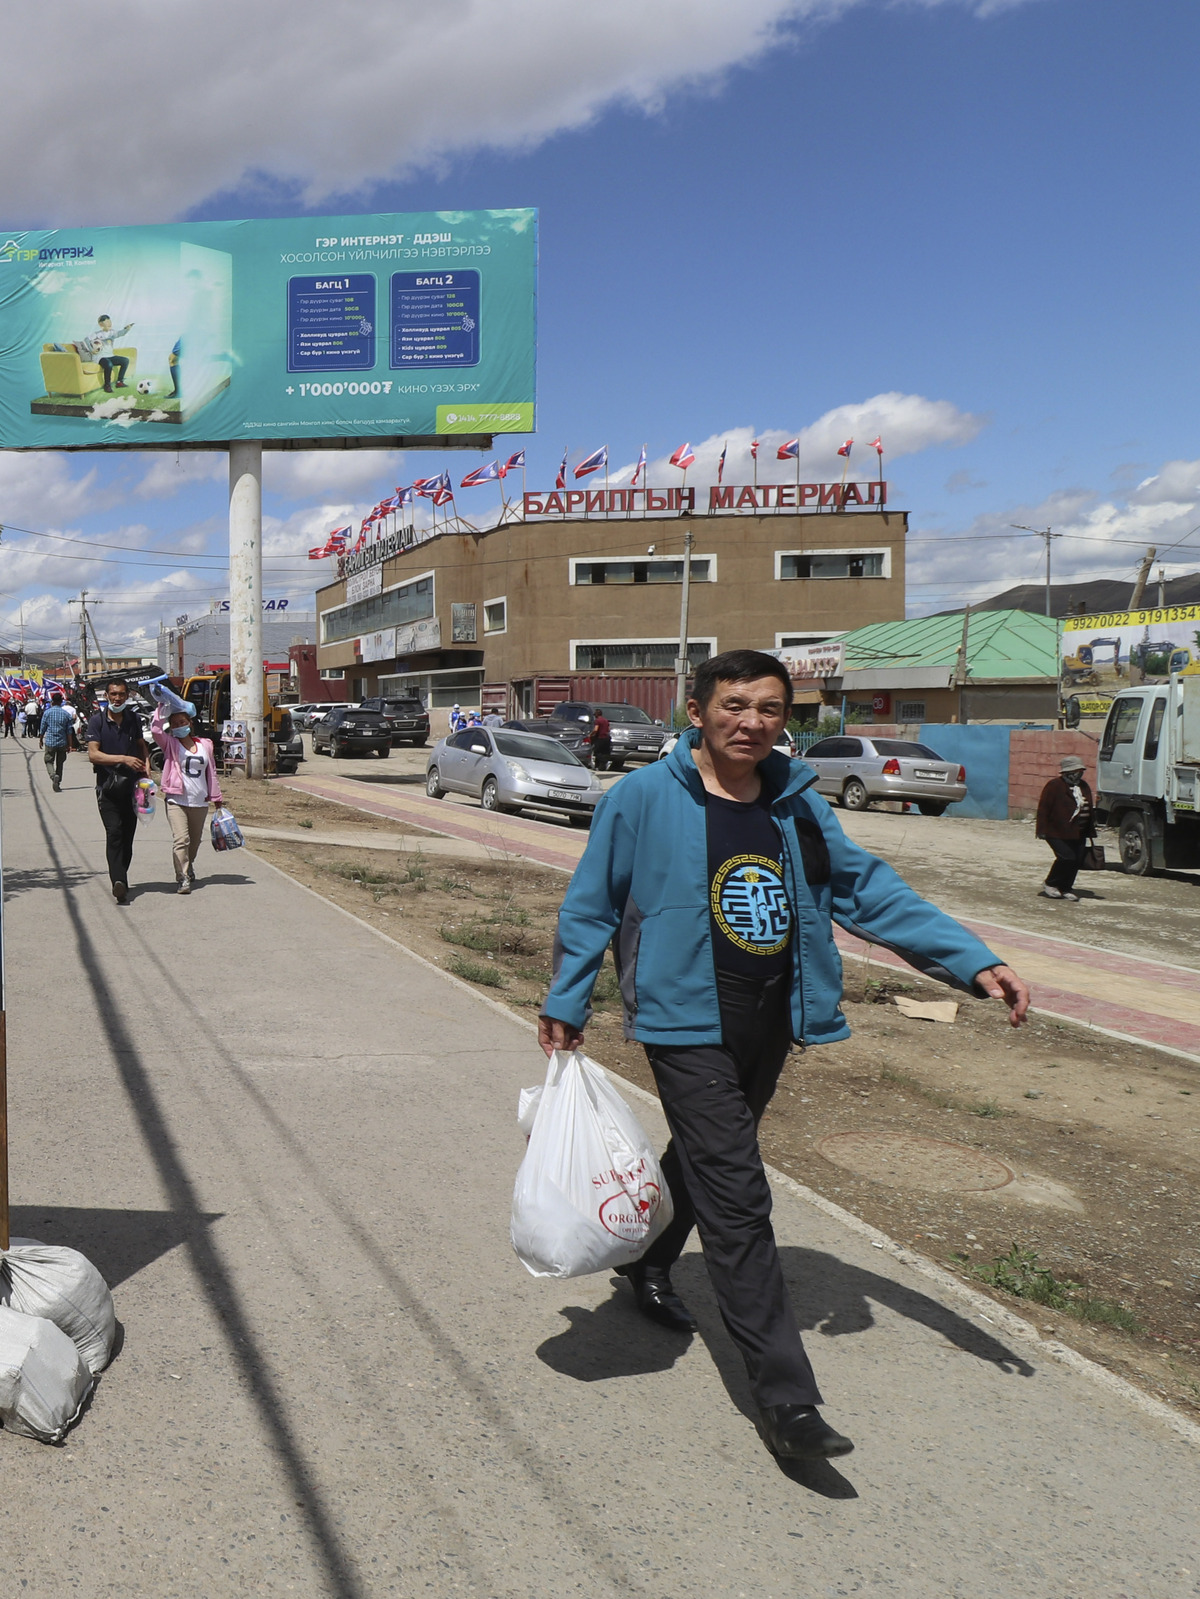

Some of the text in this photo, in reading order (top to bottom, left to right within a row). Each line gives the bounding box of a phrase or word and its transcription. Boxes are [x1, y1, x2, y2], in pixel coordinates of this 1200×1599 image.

[316, 232, 452, 248] ГЭР ИНТЕРНЭТ ДДЭШ
[280, 245, 491, 264] ХОСОЛСОН ҮЙЛЧИЛГЭЭ НЭВТЭРЛЭЭ
[315, 278, 350, 290] БАГЦ 1
[415, 274, 453, 286] БАГЦ 2
[398, 384, 428, 394] КИНО
[523, 481, 888, 514] БАРИЛГЫН МАТЕРИАЛ
[1072, 606, 1200, 630] 99270022 9191354
[186, 756, 204, 778] C
